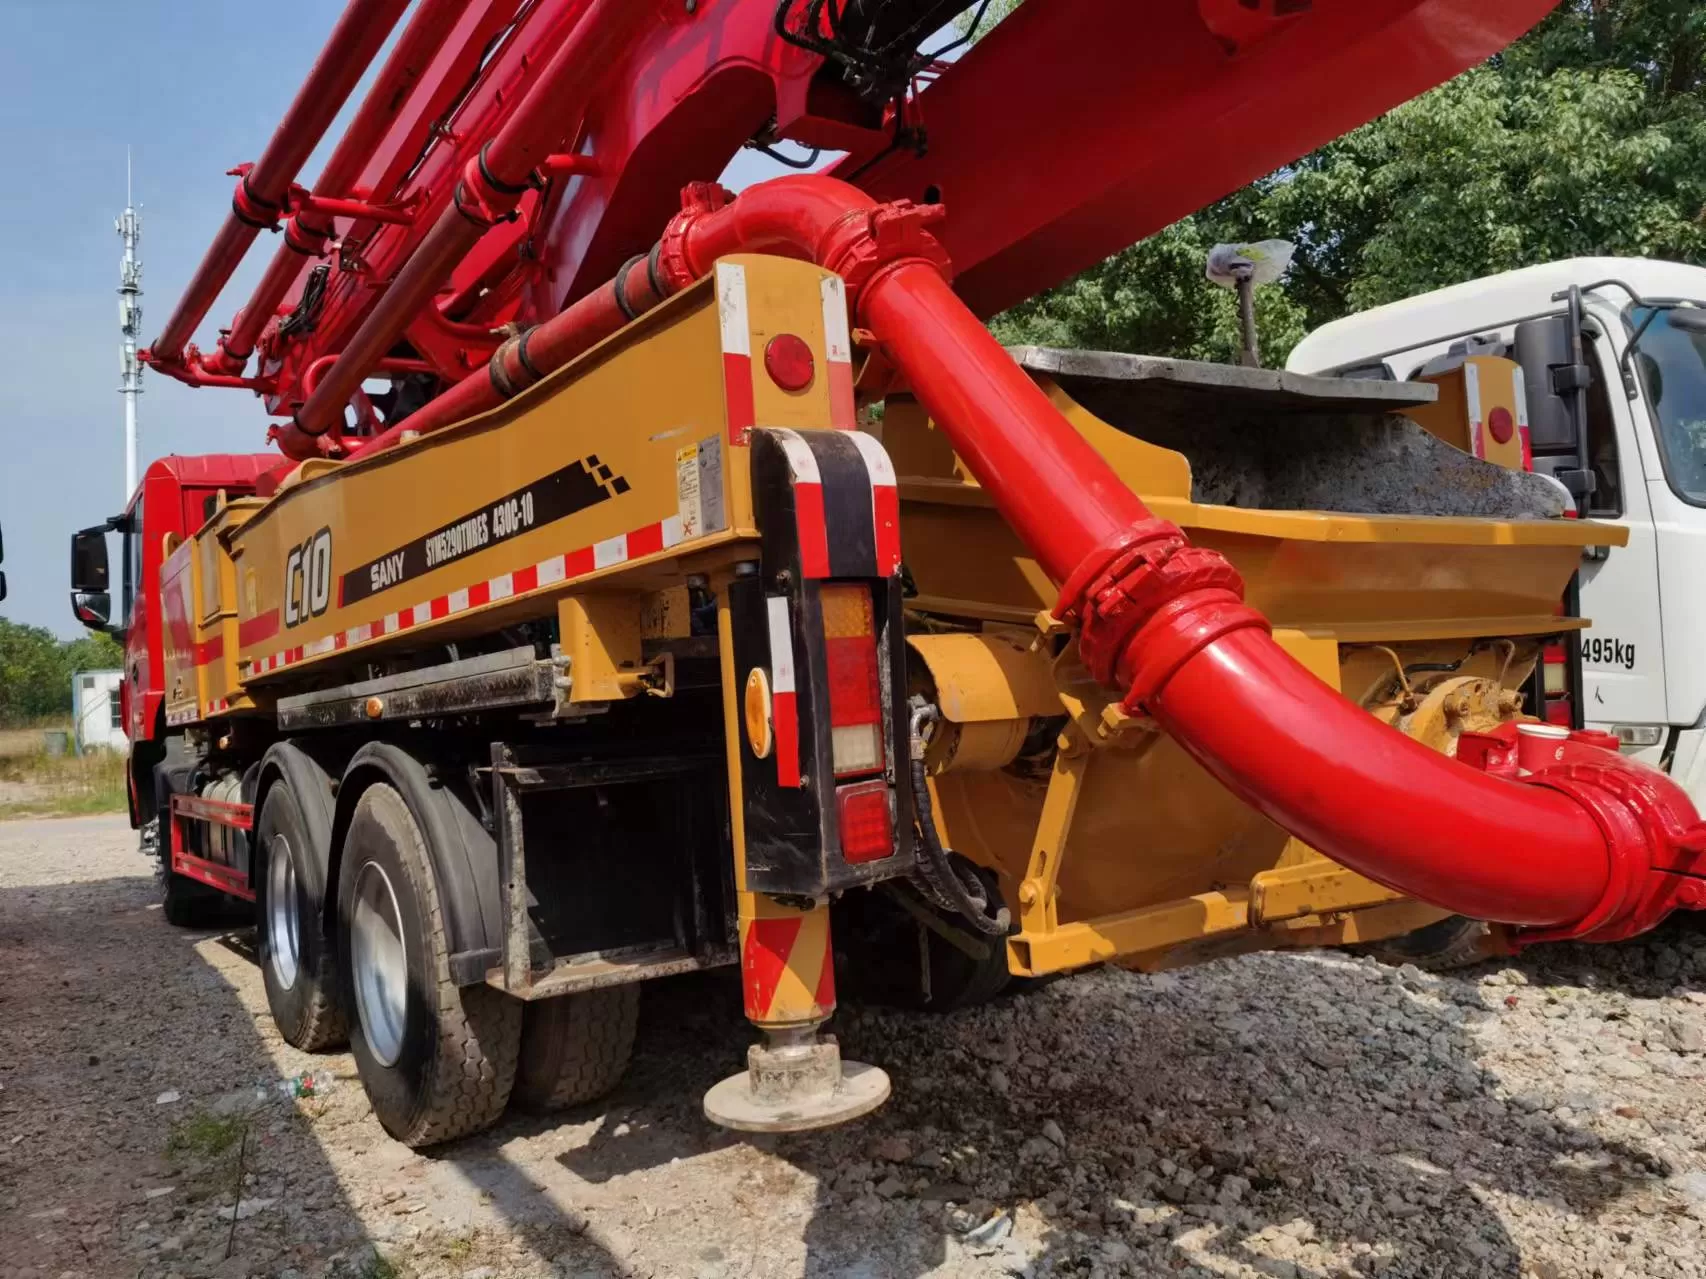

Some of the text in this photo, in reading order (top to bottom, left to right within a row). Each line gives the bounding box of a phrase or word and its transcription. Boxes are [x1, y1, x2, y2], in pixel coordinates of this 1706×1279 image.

[285, 525, 332, 629] C10
[370, 551, 405, 592] SANY
[492, 491, 534, 538] 430C-10
